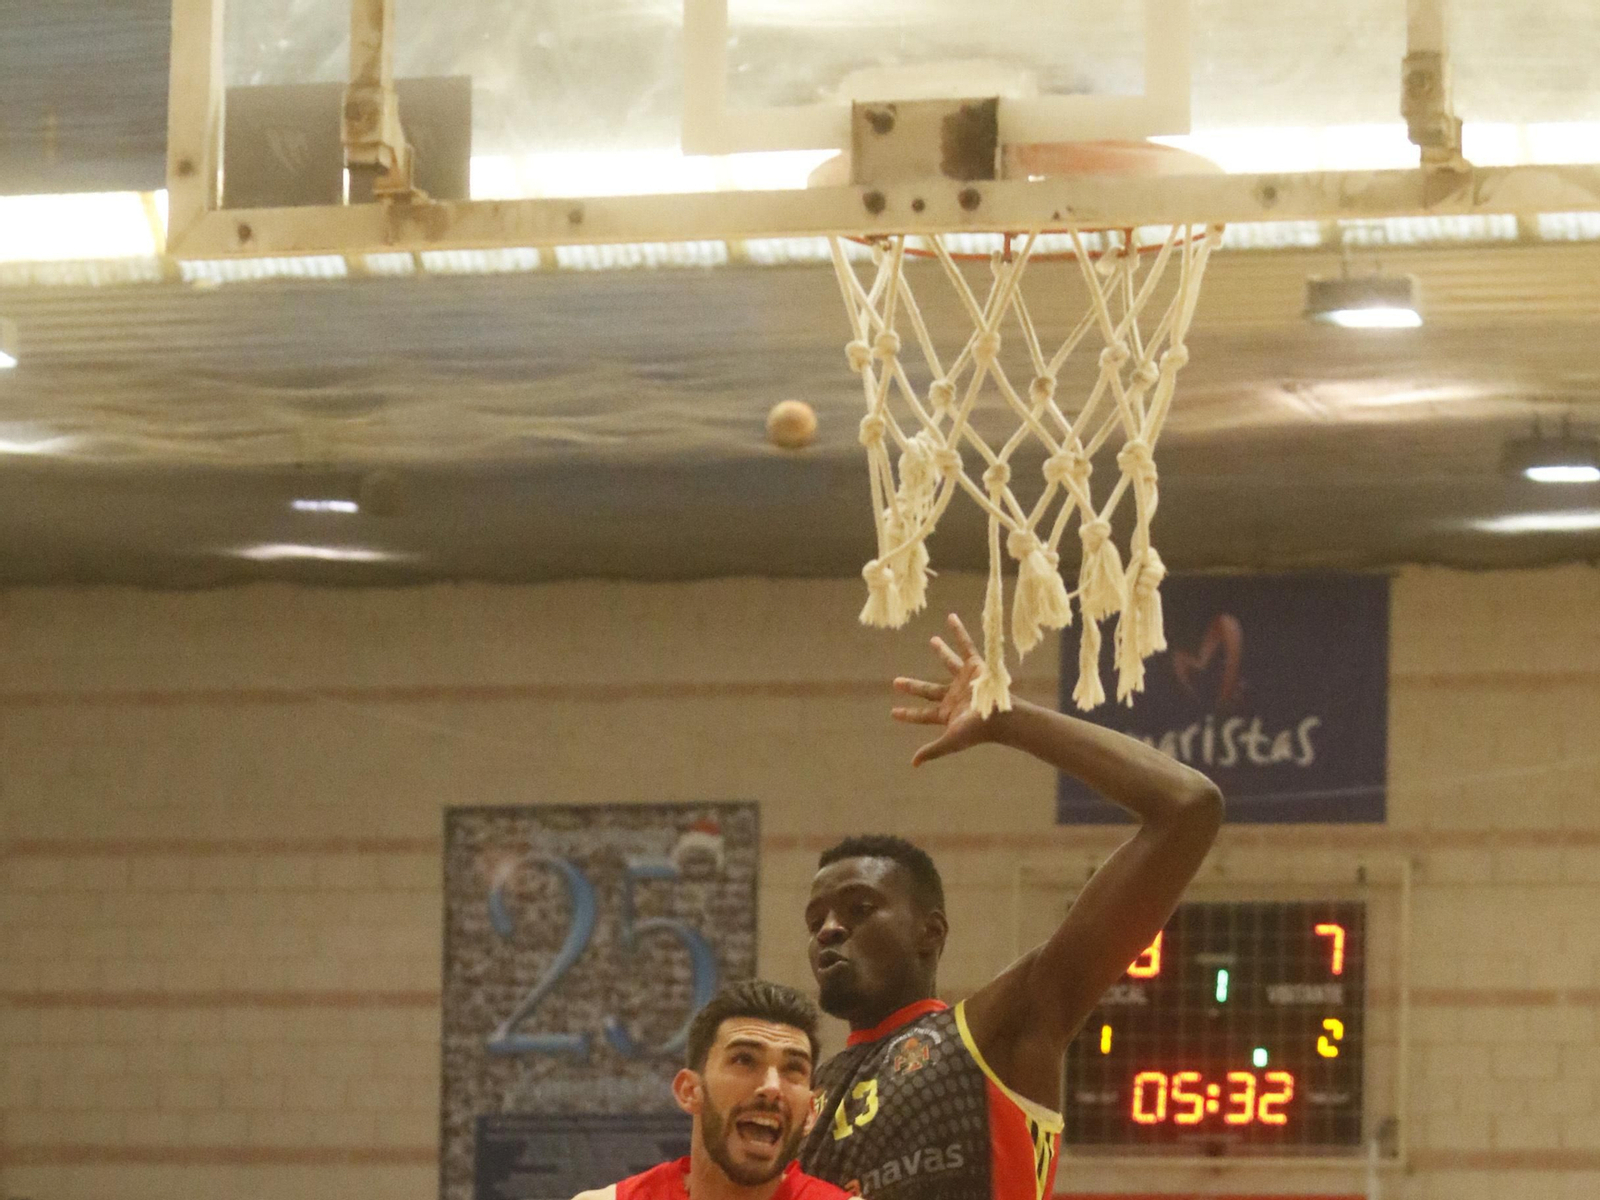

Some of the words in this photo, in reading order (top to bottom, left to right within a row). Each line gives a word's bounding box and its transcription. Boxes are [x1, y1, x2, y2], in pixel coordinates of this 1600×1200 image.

[1142, 713, 1322, 767] aristas
[1314, 923, 1345, 976] 7
[1215, 968, 1229, 1003] 1
[1100, 1024, 1113, 1055] 1
[1131, 1070, 1295, 1125] 05:32
